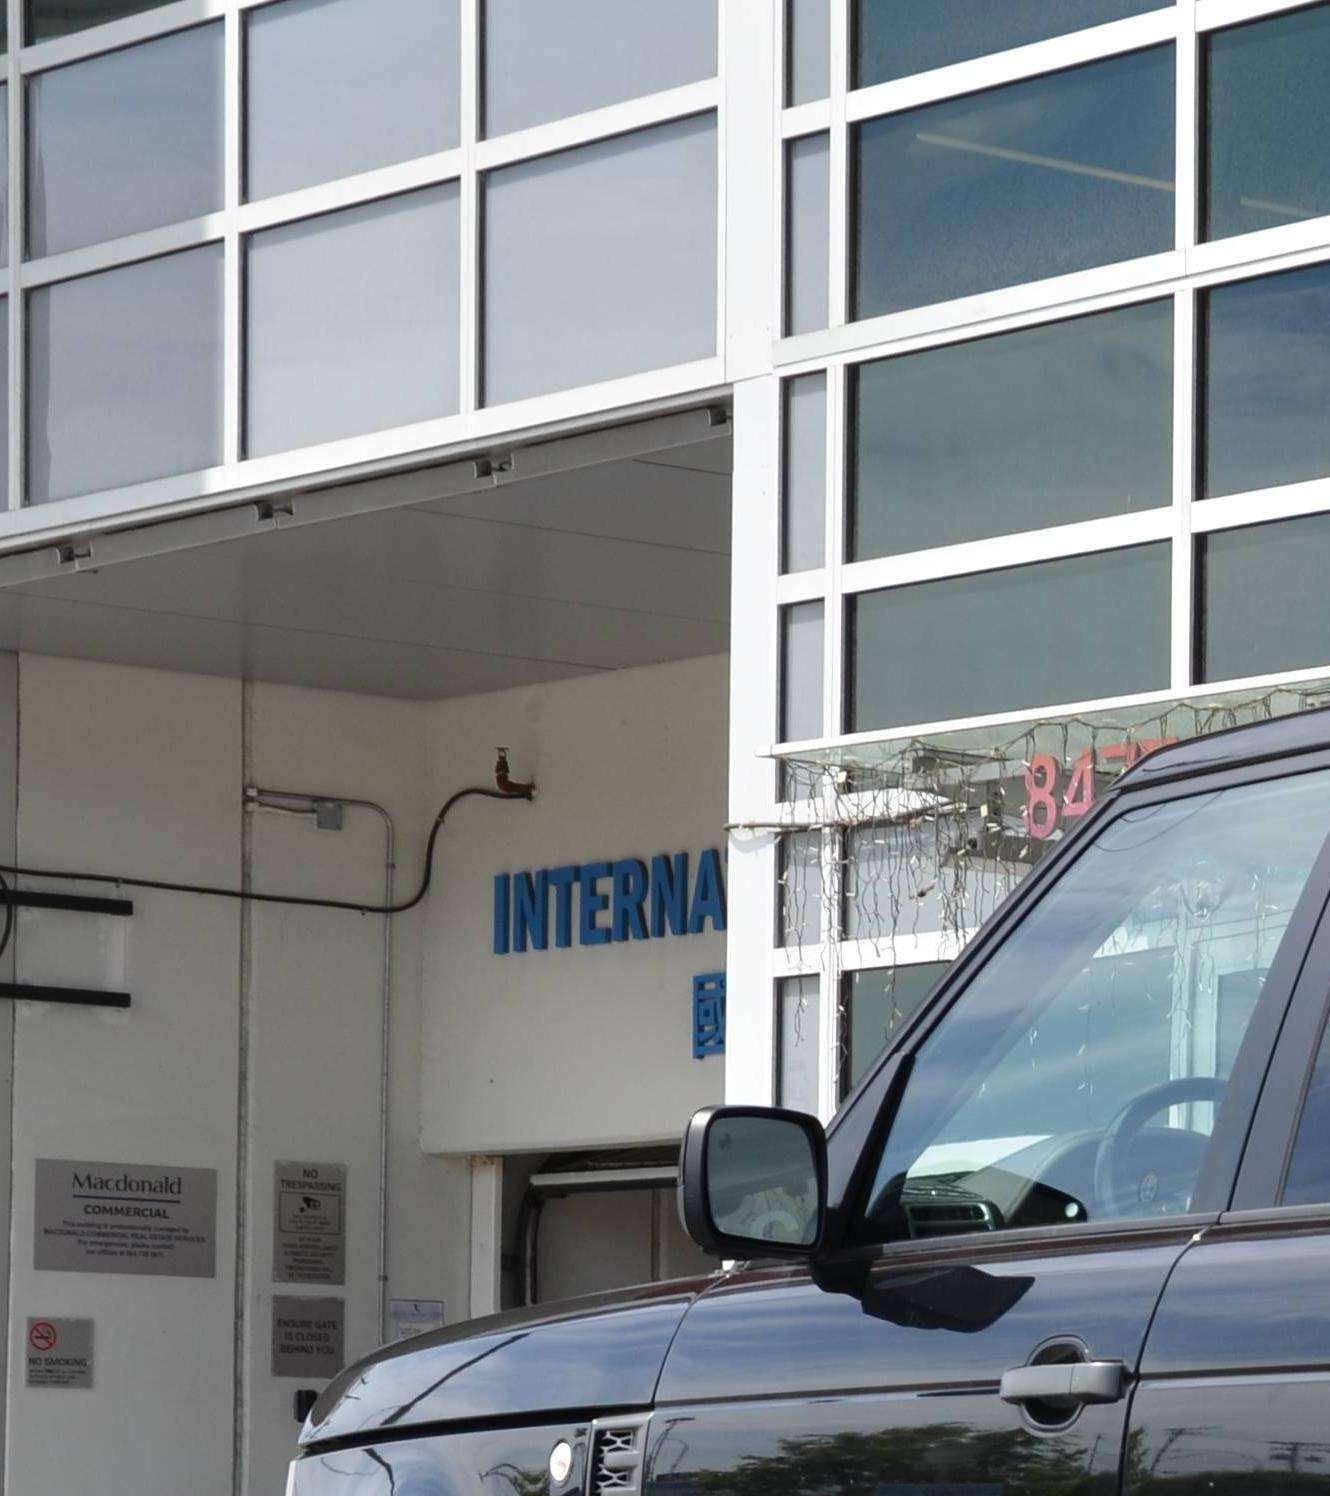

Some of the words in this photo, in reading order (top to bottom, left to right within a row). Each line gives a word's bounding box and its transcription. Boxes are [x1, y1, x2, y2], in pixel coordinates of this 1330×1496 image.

[494, 848, 727, 956] INTERNA
[303, 1168, 318, 1179] NO
[72, 1172, 183, 1195] Macdonald
[84, 1204, 170, 1219] COMMERCIAL
